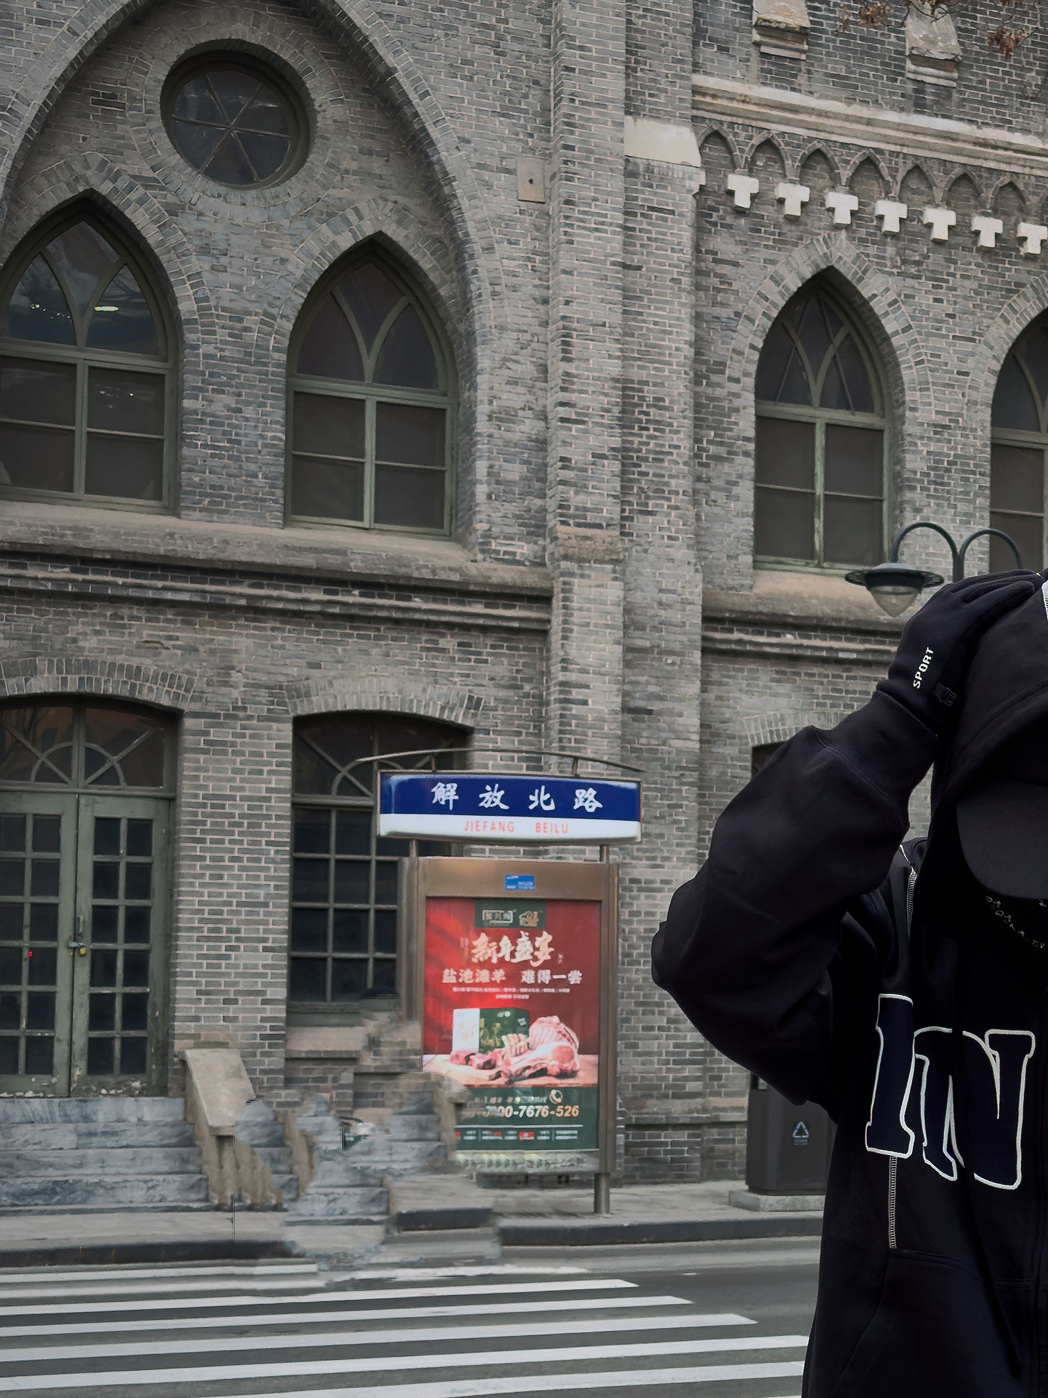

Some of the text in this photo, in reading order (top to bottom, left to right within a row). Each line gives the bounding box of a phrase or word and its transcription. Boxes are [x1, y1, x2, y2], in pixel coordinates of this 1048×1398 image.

[912, 646, 934, 689] SPORT
[430, 781, 603, 813] 解放北路
[463, 820, 569, 834] JIEFANG BEILU
[471, 930, 555, 968] 新年盛宴
